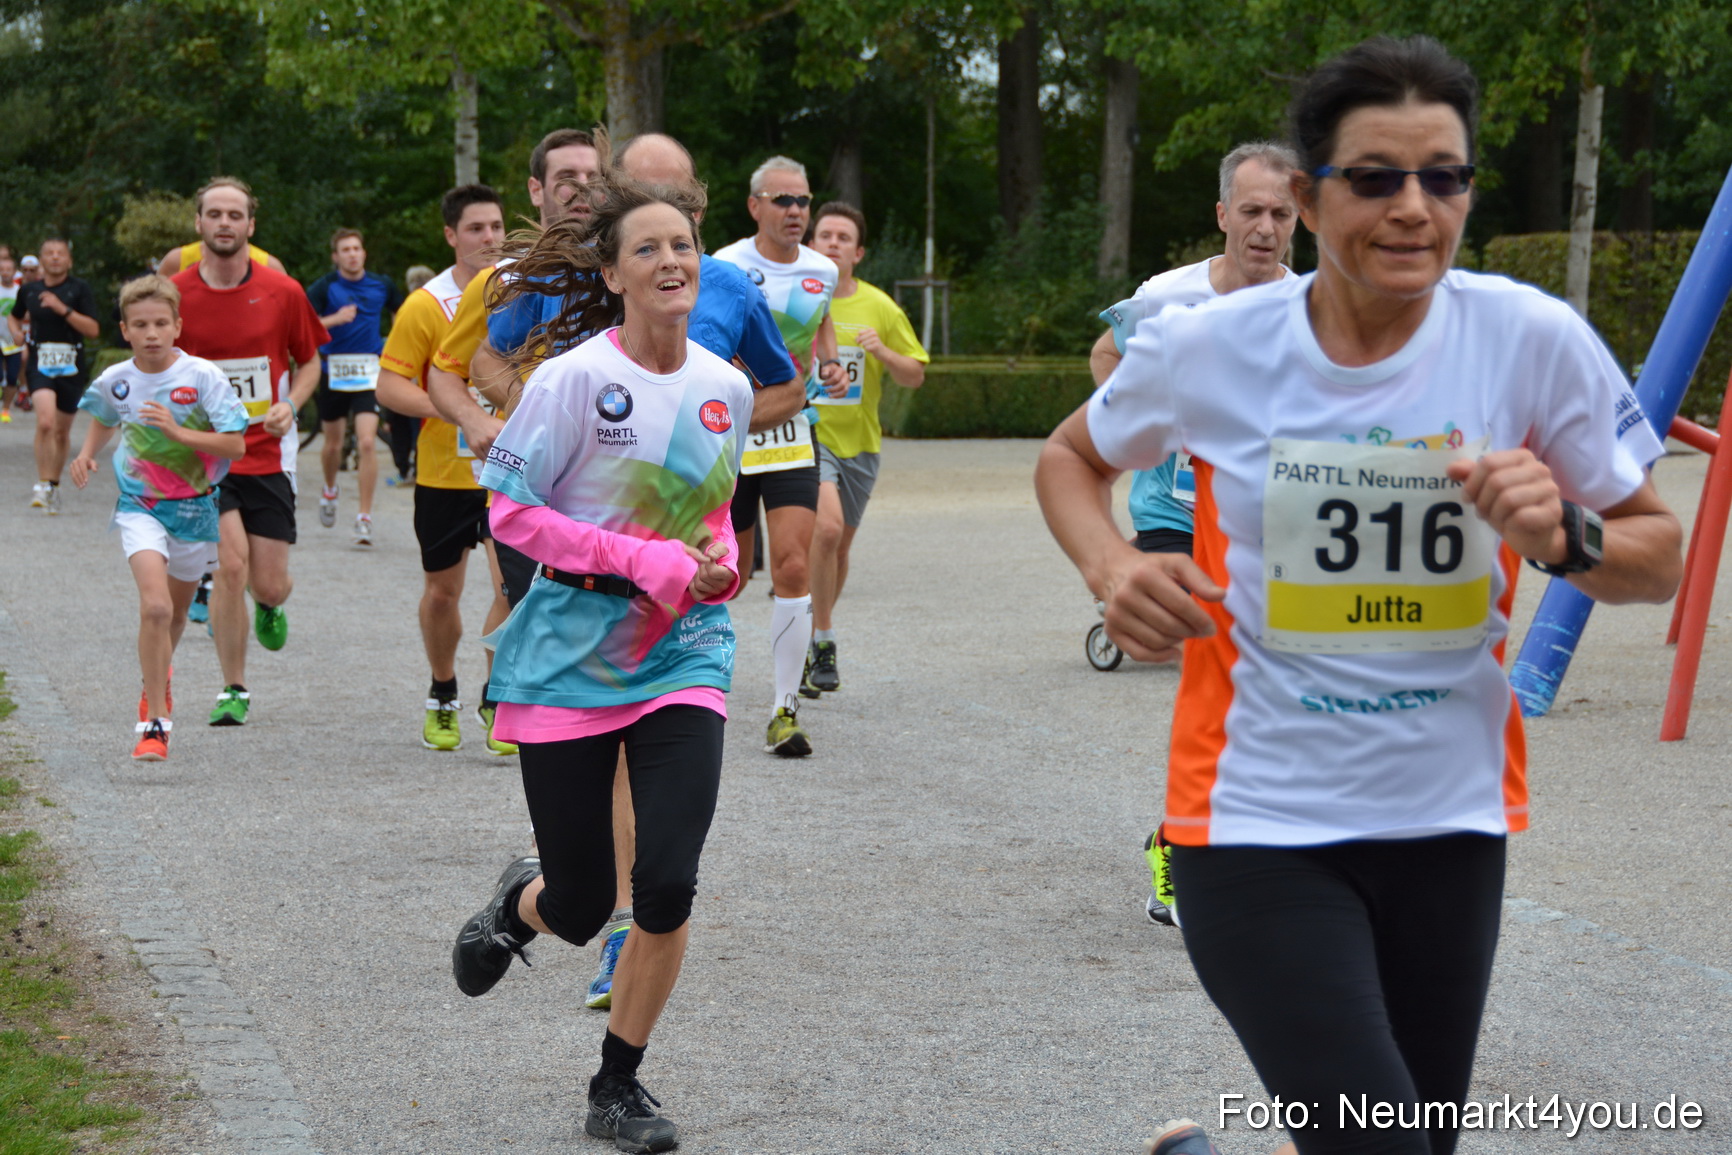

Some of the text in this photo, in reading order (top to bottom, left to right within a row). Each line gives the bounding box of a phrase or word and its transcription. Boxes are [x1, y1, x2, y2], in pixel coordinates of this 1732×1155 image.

[704, 407, 730, 426] Hervis
[597, 427, 638, 438] PARTL
[598, 438, 638, 446] Neumarkt
[1273, 462, 1464, 490] PARTL Neumark
[1314, 498, 1464, 574] 316
[1274, 565, 1282, 578] B
[1346, 595, 1423, 624] Jutta
